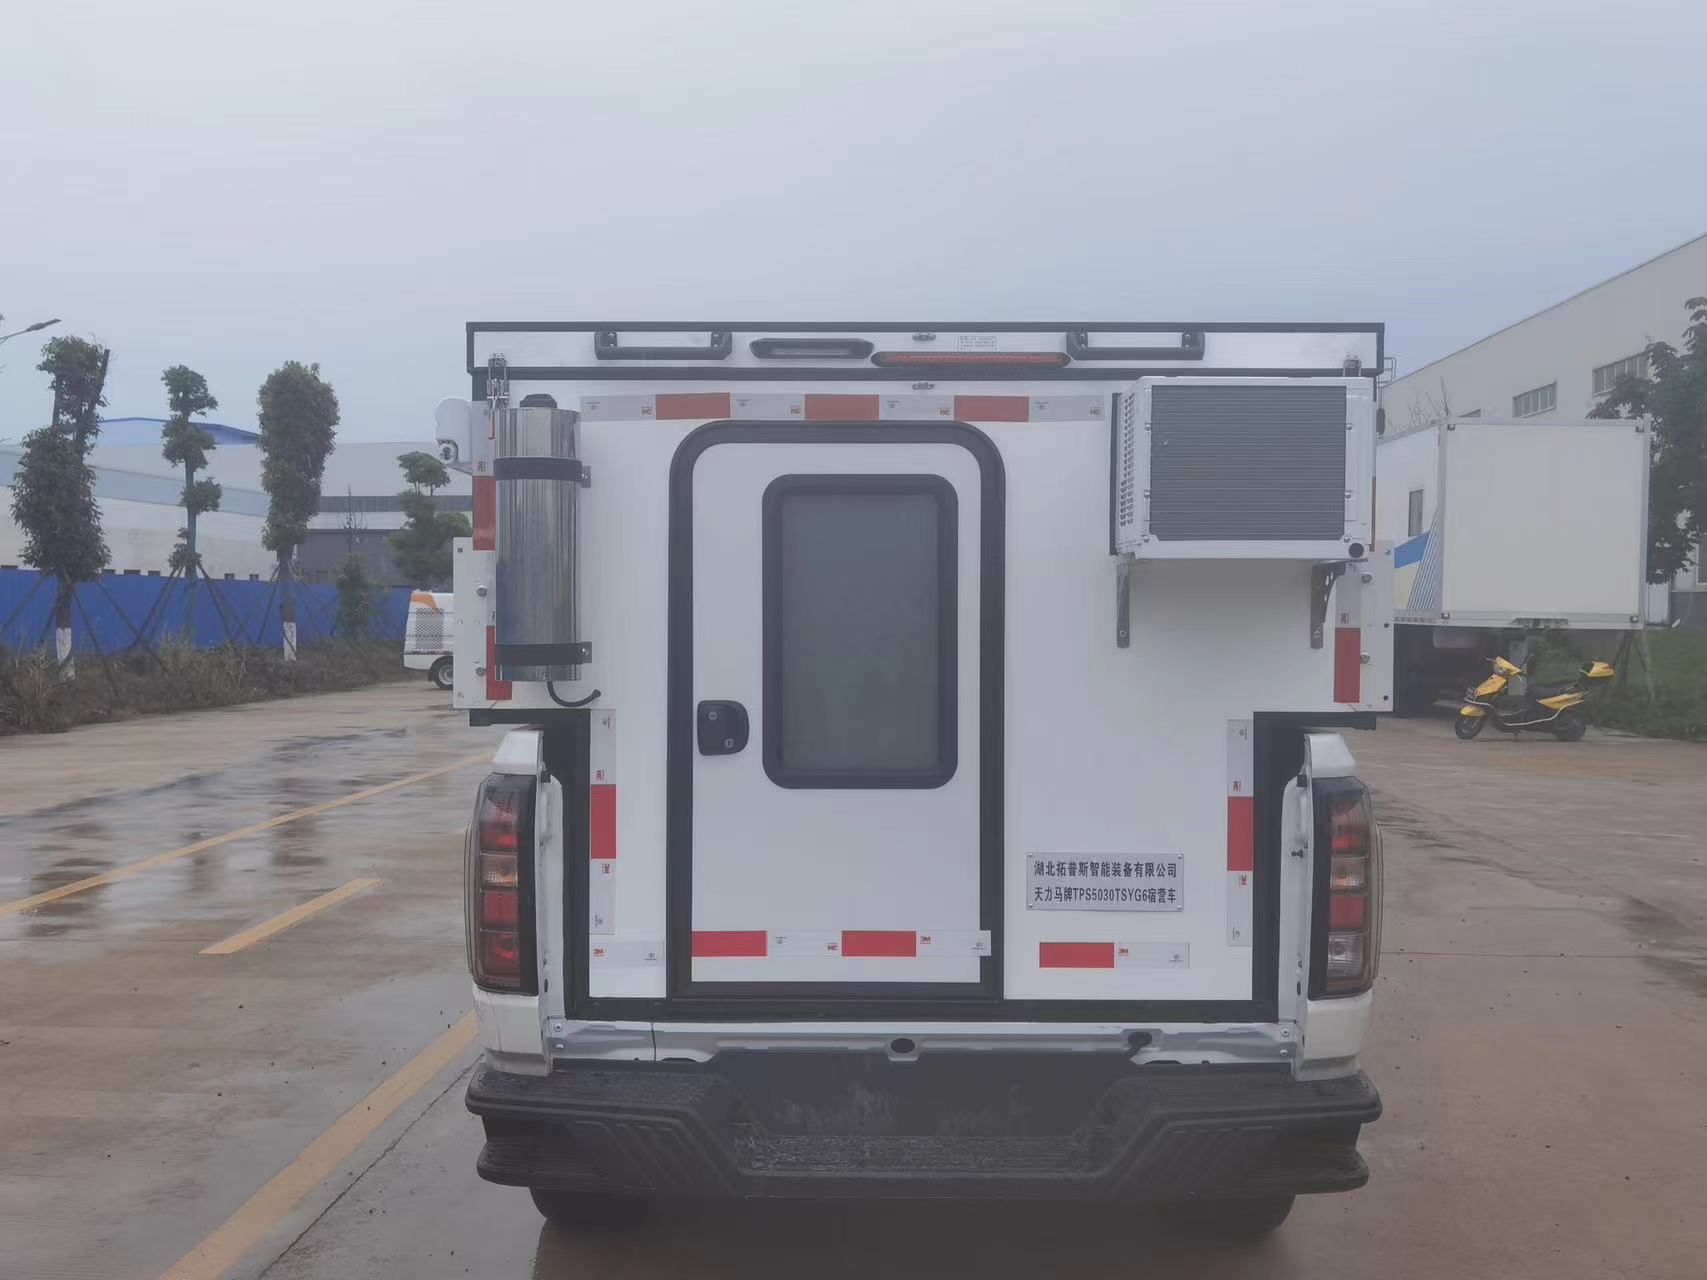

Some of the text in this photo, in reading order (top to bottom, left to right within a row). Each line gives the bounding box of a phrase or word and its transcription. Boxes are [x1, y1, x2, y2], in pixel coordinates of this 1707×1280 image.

[1033, 860, 1178, 878] 湖北拓普斯智能装备有限公司
